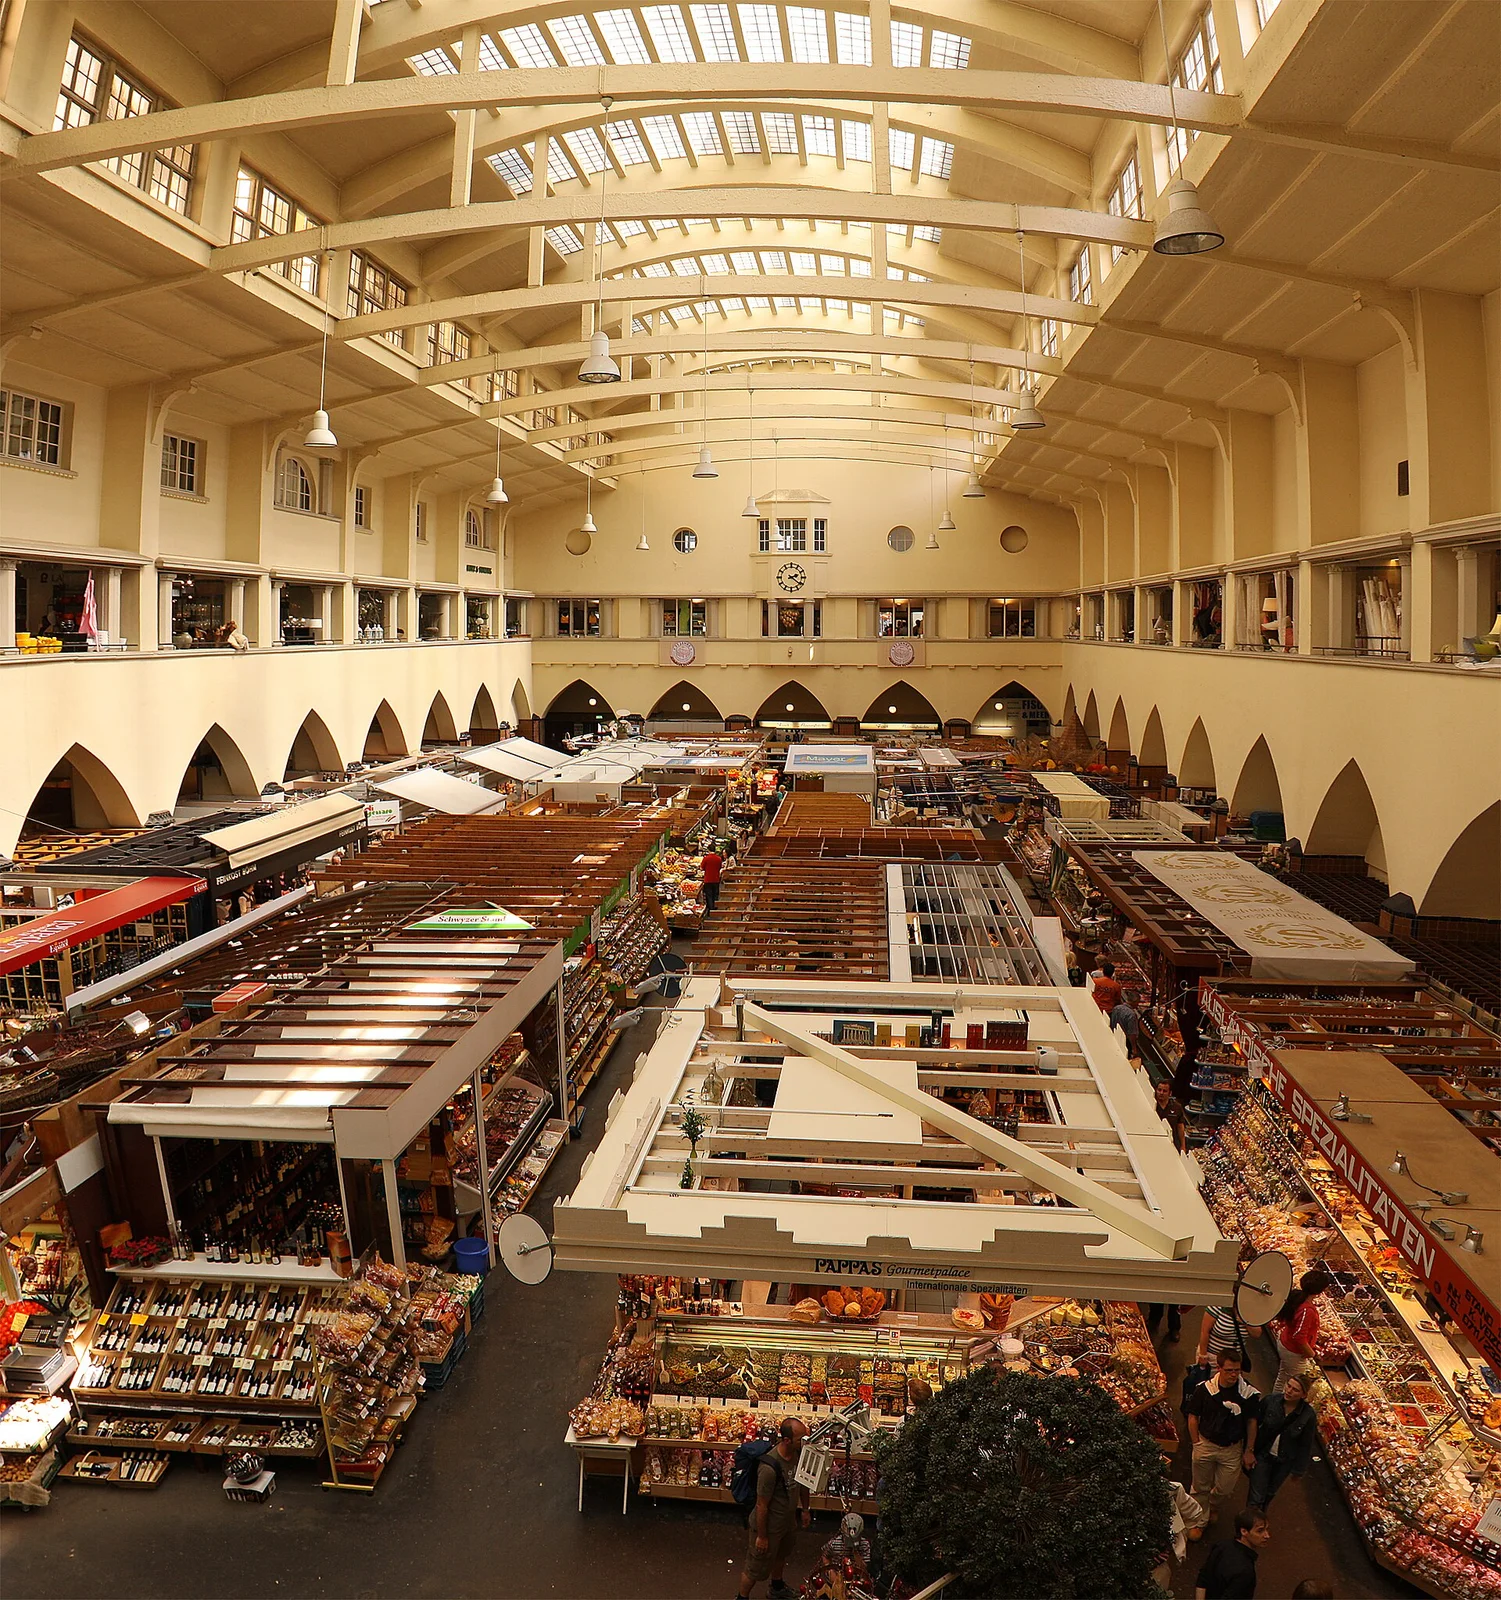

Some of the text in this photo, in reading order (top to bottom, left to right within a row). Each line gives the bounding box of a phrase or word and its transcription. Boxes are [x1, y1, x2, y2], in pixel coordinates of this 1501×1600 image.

[216, 869, 241, 886] FEINKOST
[437, 915, 478, 925] Schwyzer
[1291, 1088, 1436, 1279] SPEZIALITÄTEN
[815, 1258, 971, 1278] PAPPAS Gourmetpalace
[906, 1280, 1028, 1295] Internationale Spezialitäten
[1465, 1289, 1494, 1327] STAND
